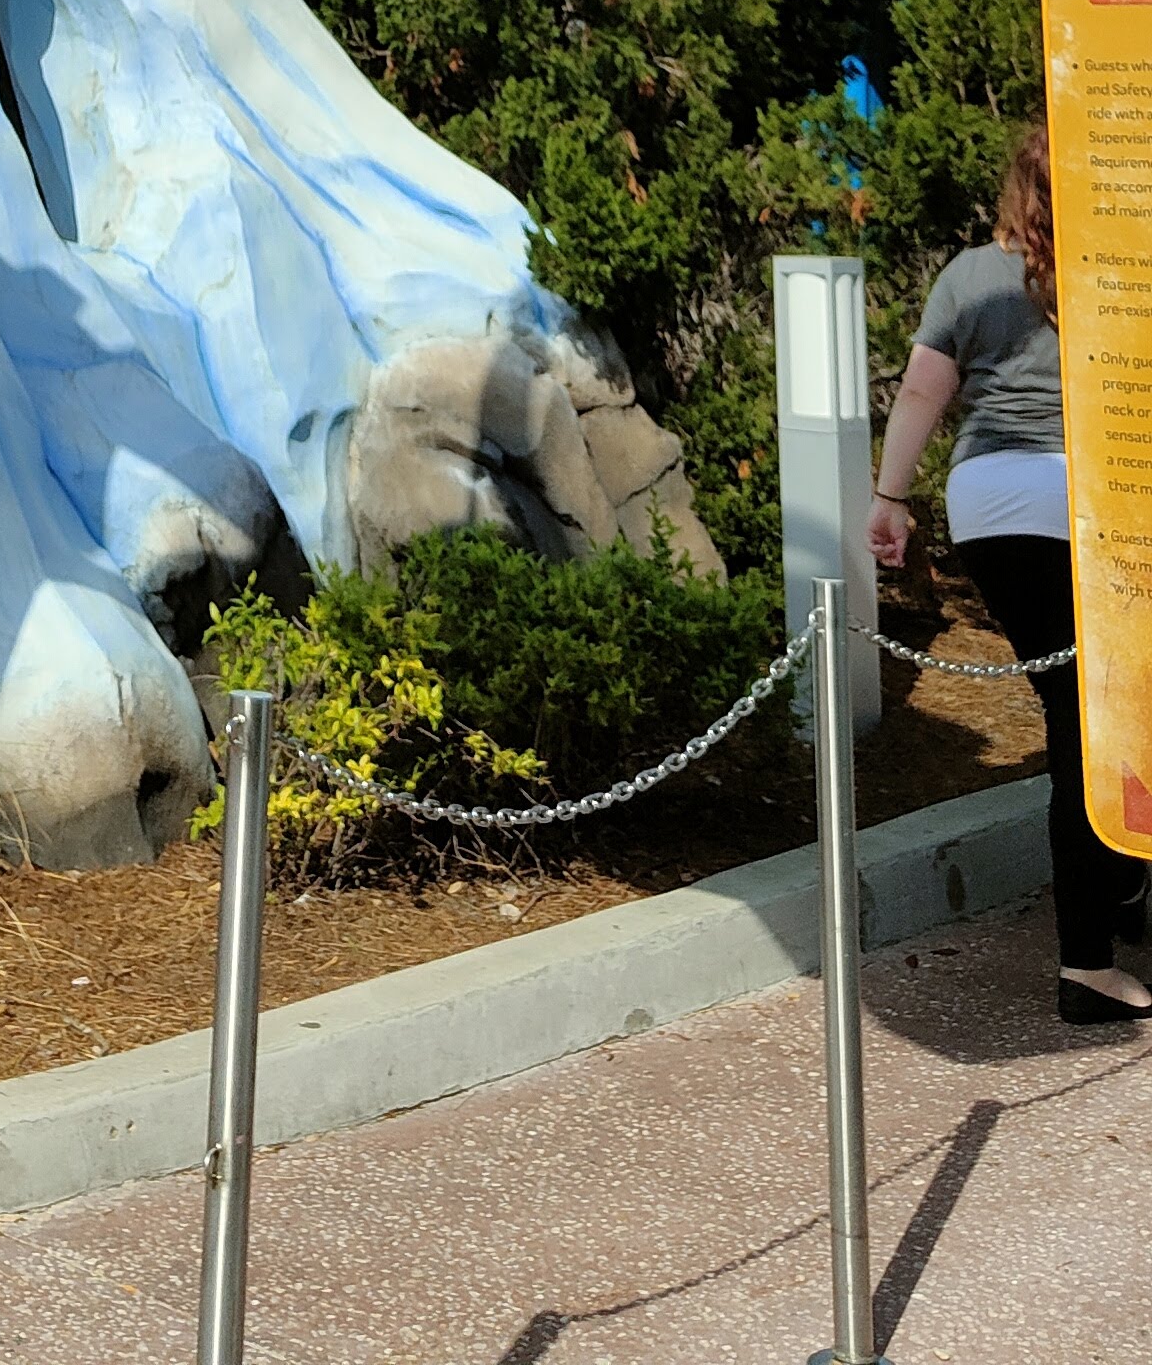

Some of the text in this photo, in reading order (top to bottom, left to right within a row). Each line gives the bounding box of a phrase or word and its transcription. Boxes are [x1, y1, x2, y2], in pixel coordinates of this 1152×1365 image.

[1084, 58, 1128, 72] Guests
[1086, 82, 1110, 96] and
[1087, 106, 1112, 120] ride
[1114, 107, 1144, 121] with
[1090, 154, 1152, 170] Requirem
[1090, 181, 1112, 192] are
[1092, 203, 1152, 219] and main
[1095, 252, 1136, 267] Riders
[1096, 275, 1152, 293] features
[1097, 303, 1152, 318] pre-exis
[1100, 351, 1130, 368] Only
[1103, 403, 1135, 418] neck
[1106, 455, 1152, 470] a recen
[1107, 477, 1138, 495] that
[1111, 555, 1137, 571] You
[1111, 582, 1145, 598] with
